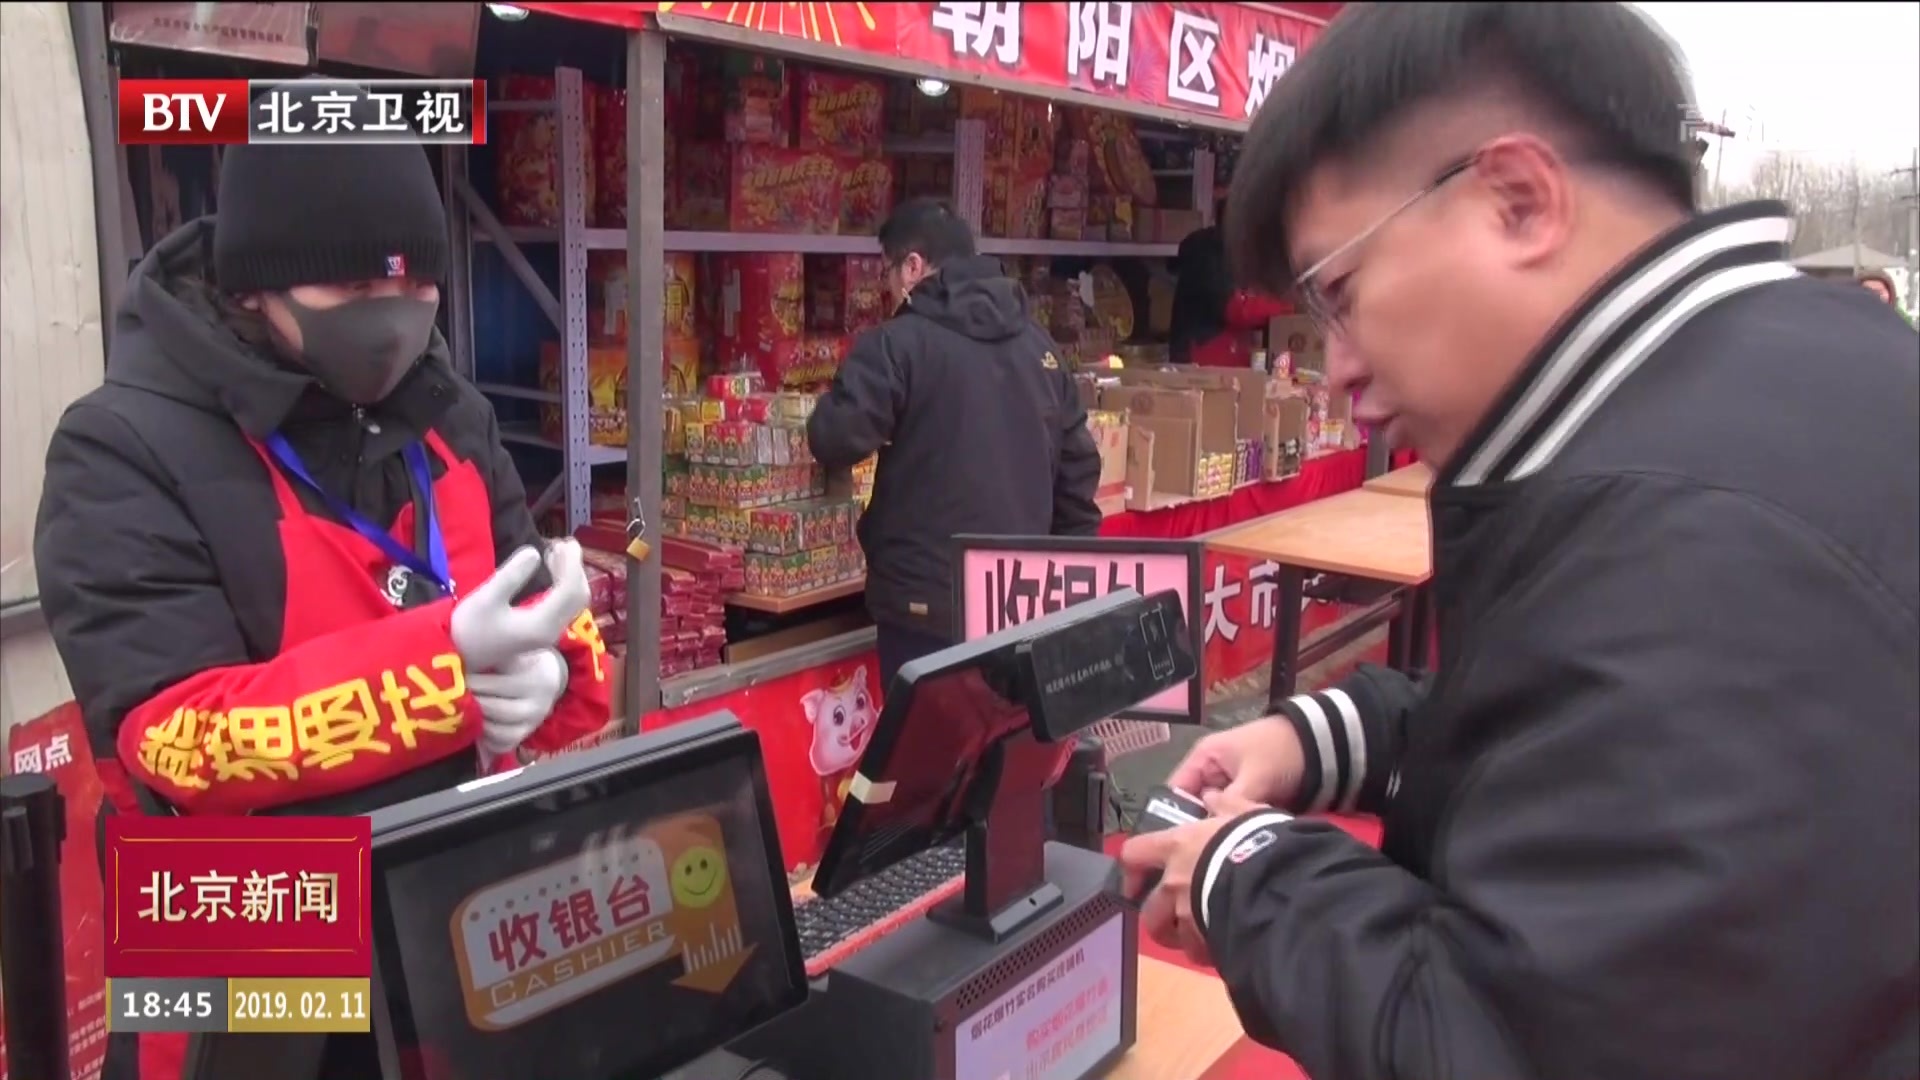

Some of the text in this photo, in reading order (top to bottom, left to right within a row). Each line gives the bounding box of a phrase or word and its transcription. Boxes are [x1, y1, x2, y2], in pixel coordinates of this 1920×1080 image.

[14, 734, 72, 774] 网点
[138, 653, 466, 790] 熊猫烟花
[488, 874, 652, 972] 收银台
[490, 922, 667, 1008] CASHIER
